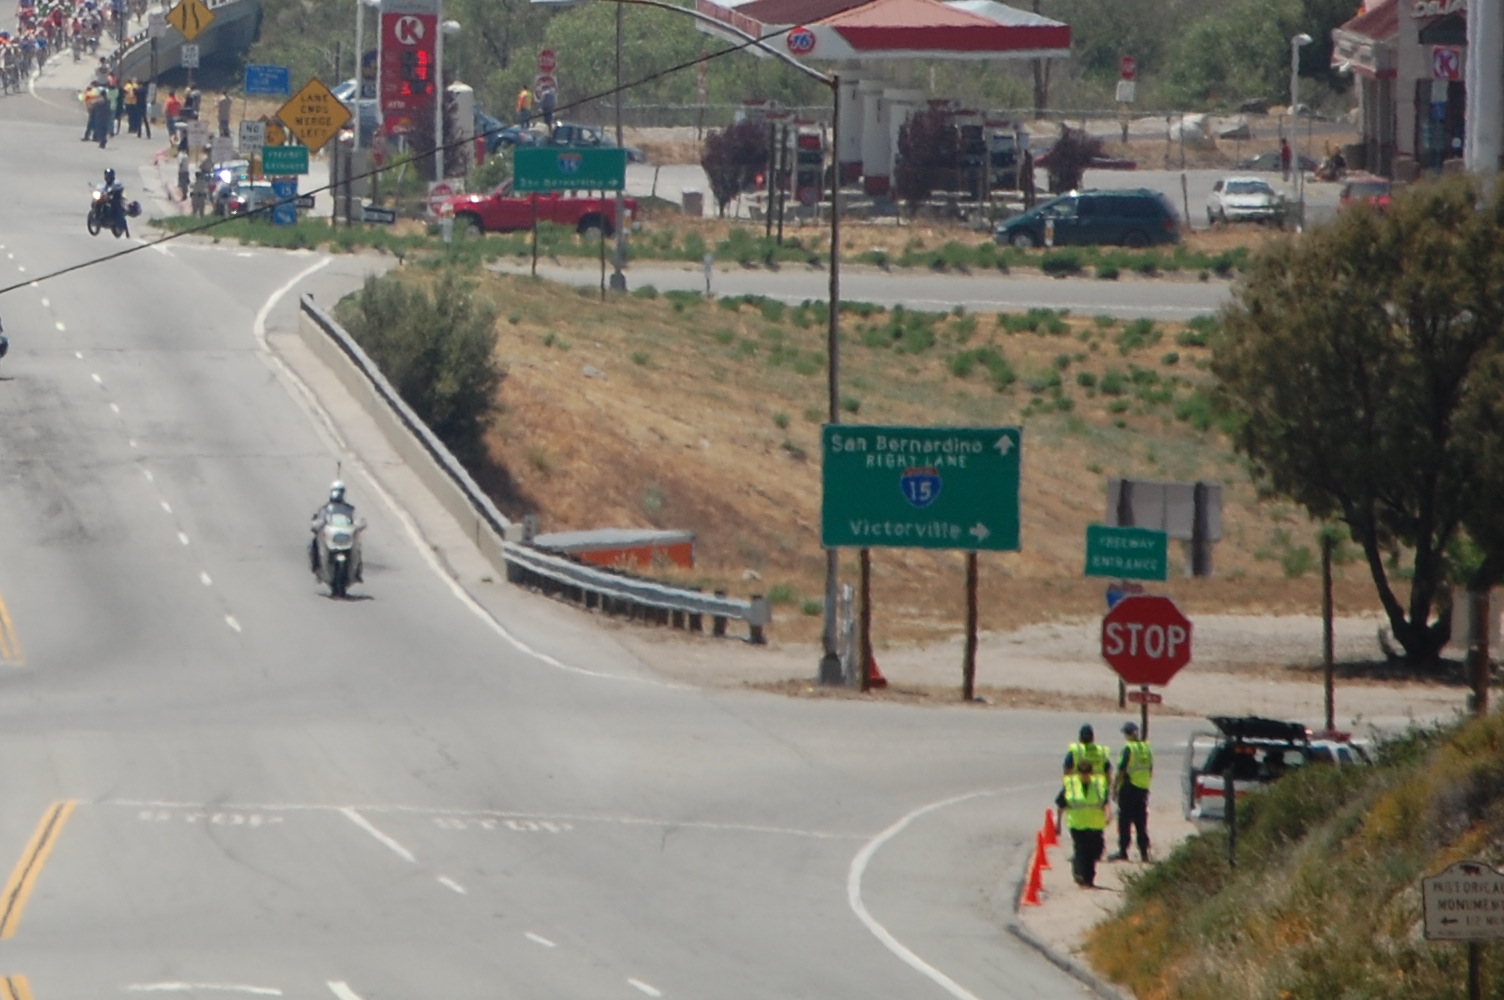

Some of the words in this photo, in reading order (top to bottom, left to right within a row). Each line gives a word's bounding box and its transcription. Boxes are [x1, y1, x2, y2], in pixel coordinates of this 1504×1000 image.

[399, 18, 424, 45] K
[790, 33, 812, 50] 76
[300, 93, 329, 103] LANE
[300, 105, 329, 114] ENDS
[246, 124, 260, 133] NO
[294, 116, 333, 126] MERGE
[300, 128, 327, 138] LEFT
[831, 433, 867, 452] San
[876, 434, 983, 454] Bernardino
[866, 454, 916, 469] RIGHT
[924, 454, 967, 469] LANE
[909, 480, 932, 501] 15
[849, 519, 962, 539] Victorville
[1099, 536, 1156, 550] FREEWAY
[1091, 556, 1159, 571] ENTRANCE
[1105, 621, 1186, 660] STOP
